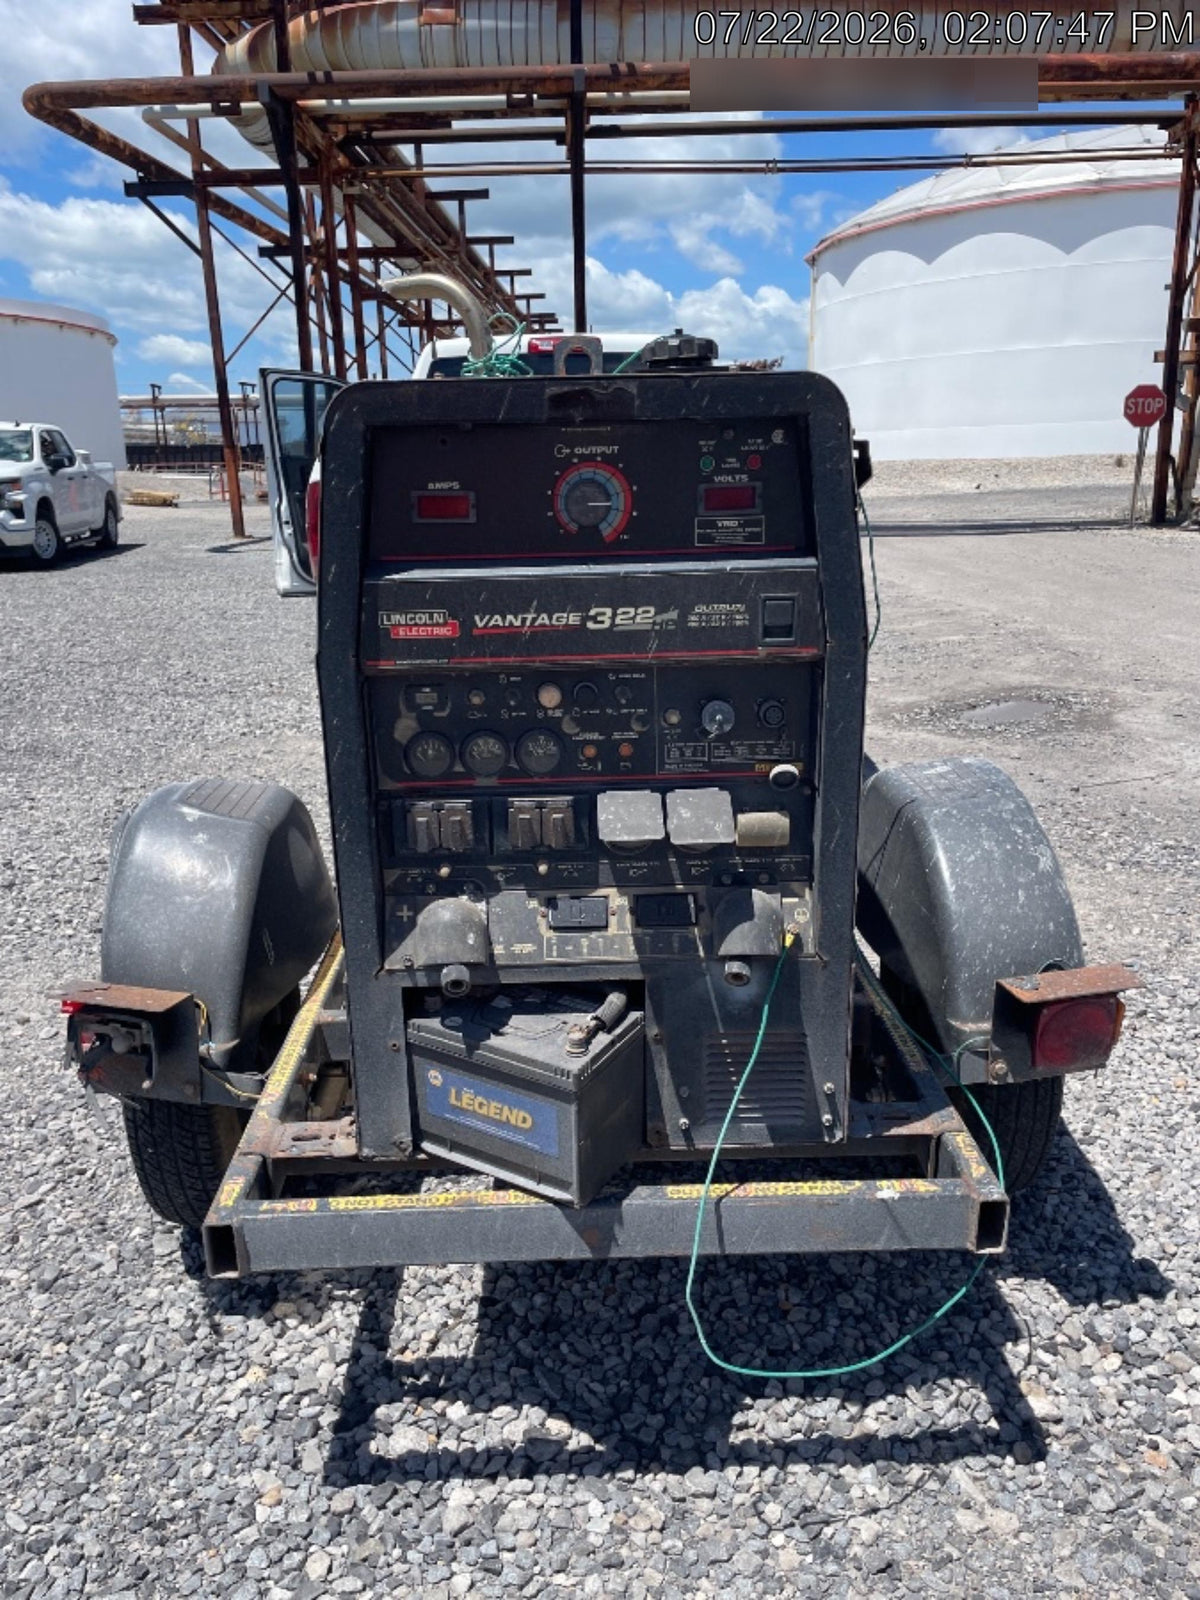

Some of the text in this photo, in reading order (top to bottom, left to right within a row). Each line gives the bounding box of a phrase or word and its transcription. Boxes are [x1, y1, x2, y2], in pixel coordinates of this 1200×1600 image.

[1126, 398, 1164, 414] STOP
[573, 446, 619, 454] OUTPUT
[713, 474, 749, 482] VOLTS
[427, 481, 460, 490] AMPS
[382, 613, 446, 626] LINCOLN
[473, 606, 655, 630] VANTAGE 322
[398, 626, 453, 636] ELECTRIC
[448, 1087, 533, 1130] LEGEND
